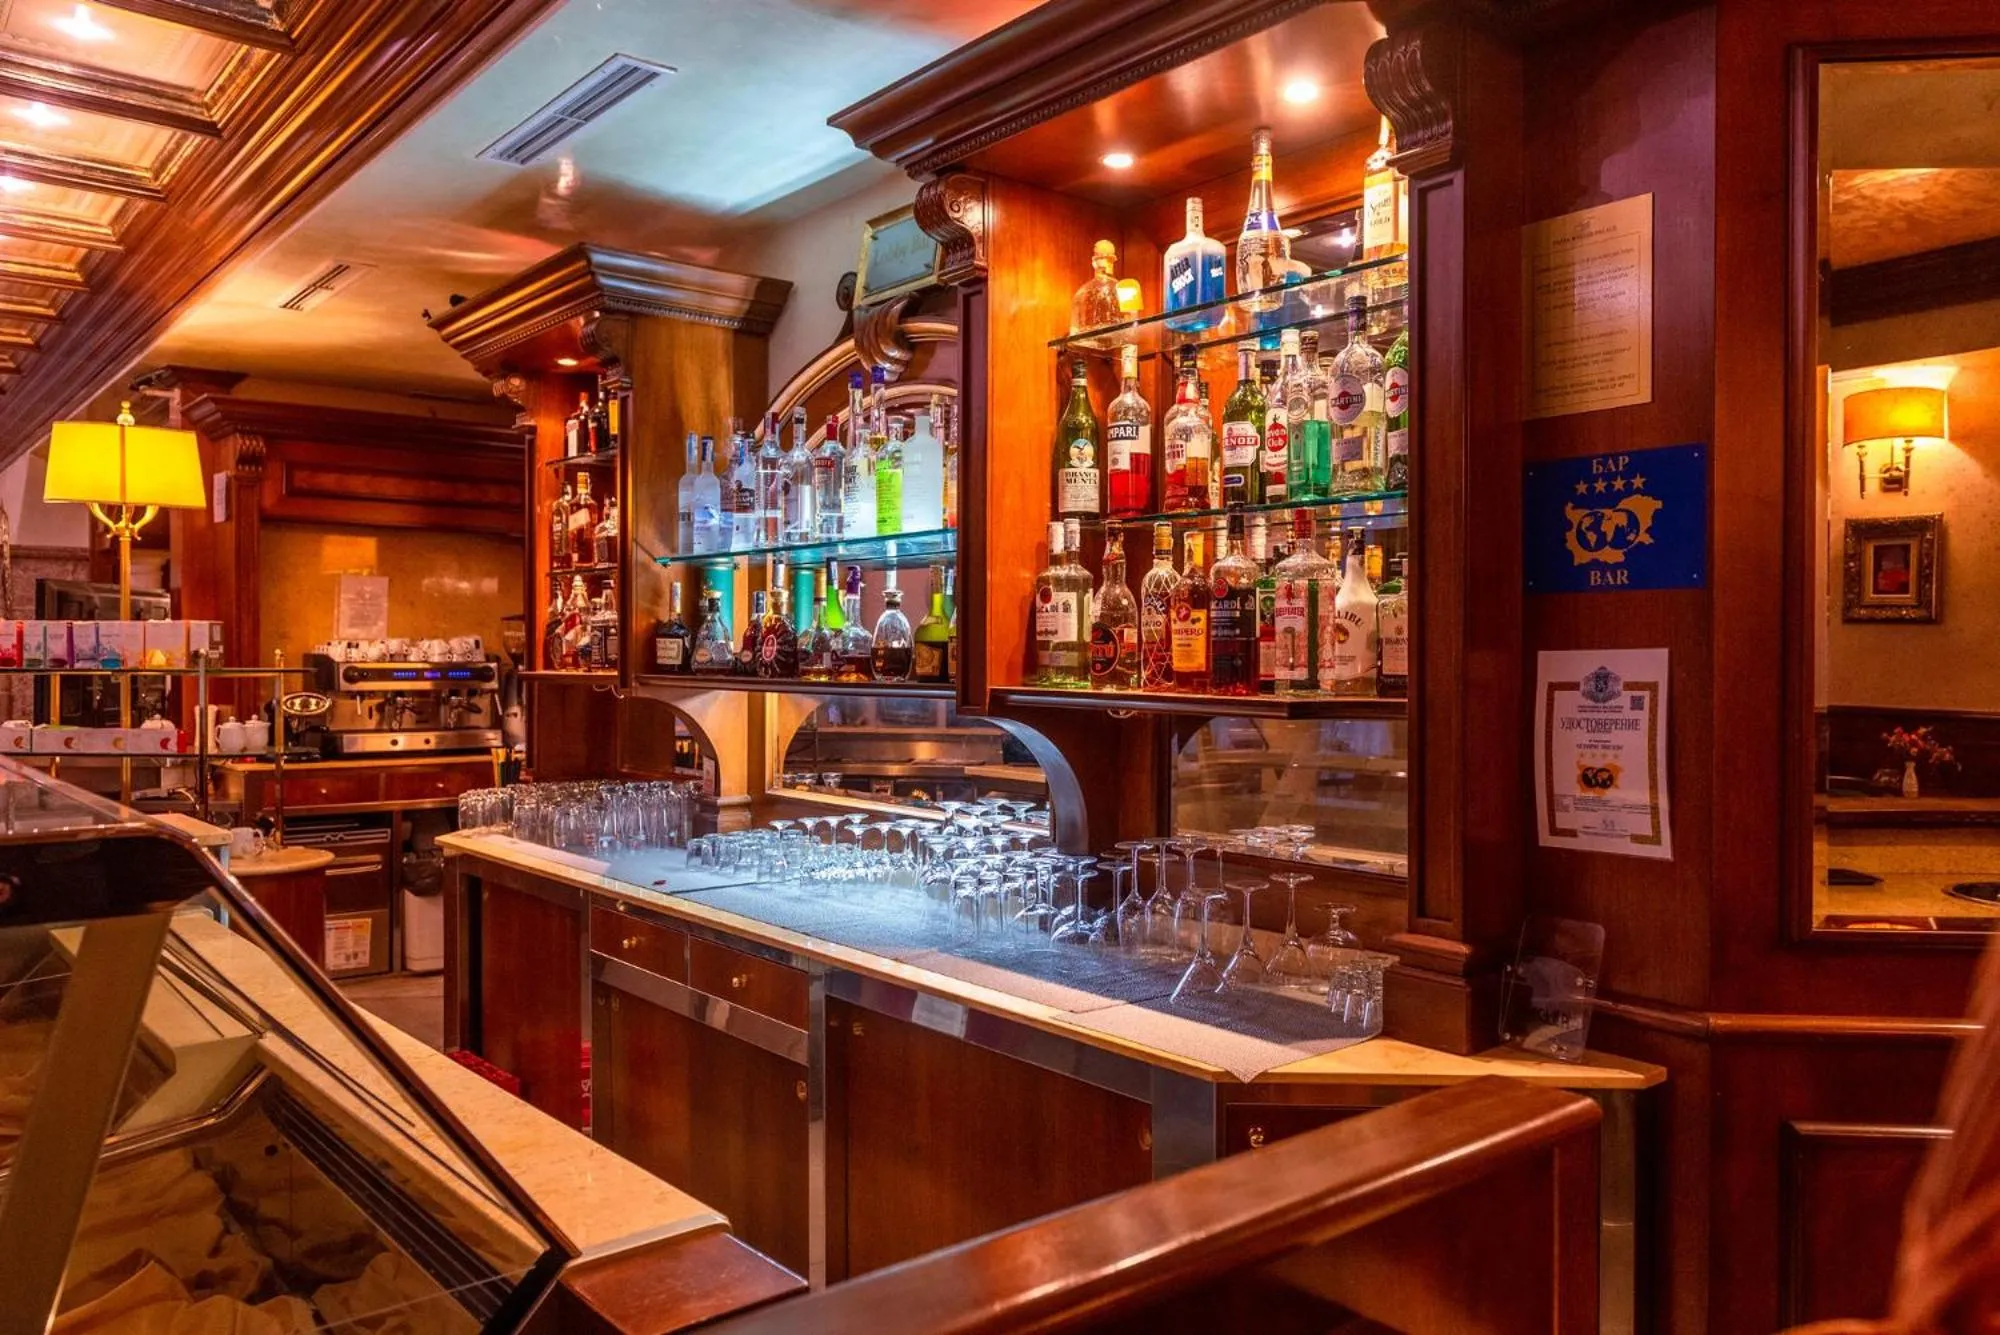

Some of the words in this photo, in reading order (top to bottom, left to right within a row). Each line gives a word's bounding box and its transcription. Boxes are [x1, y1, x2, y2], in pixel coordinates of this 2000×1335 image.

[1592, 456, 1629, 474] БАР
[1589, 569, 1629, 585] BAR
[1560, 718, 1641, 732] УДОСТОВЕРЕНИЕ
